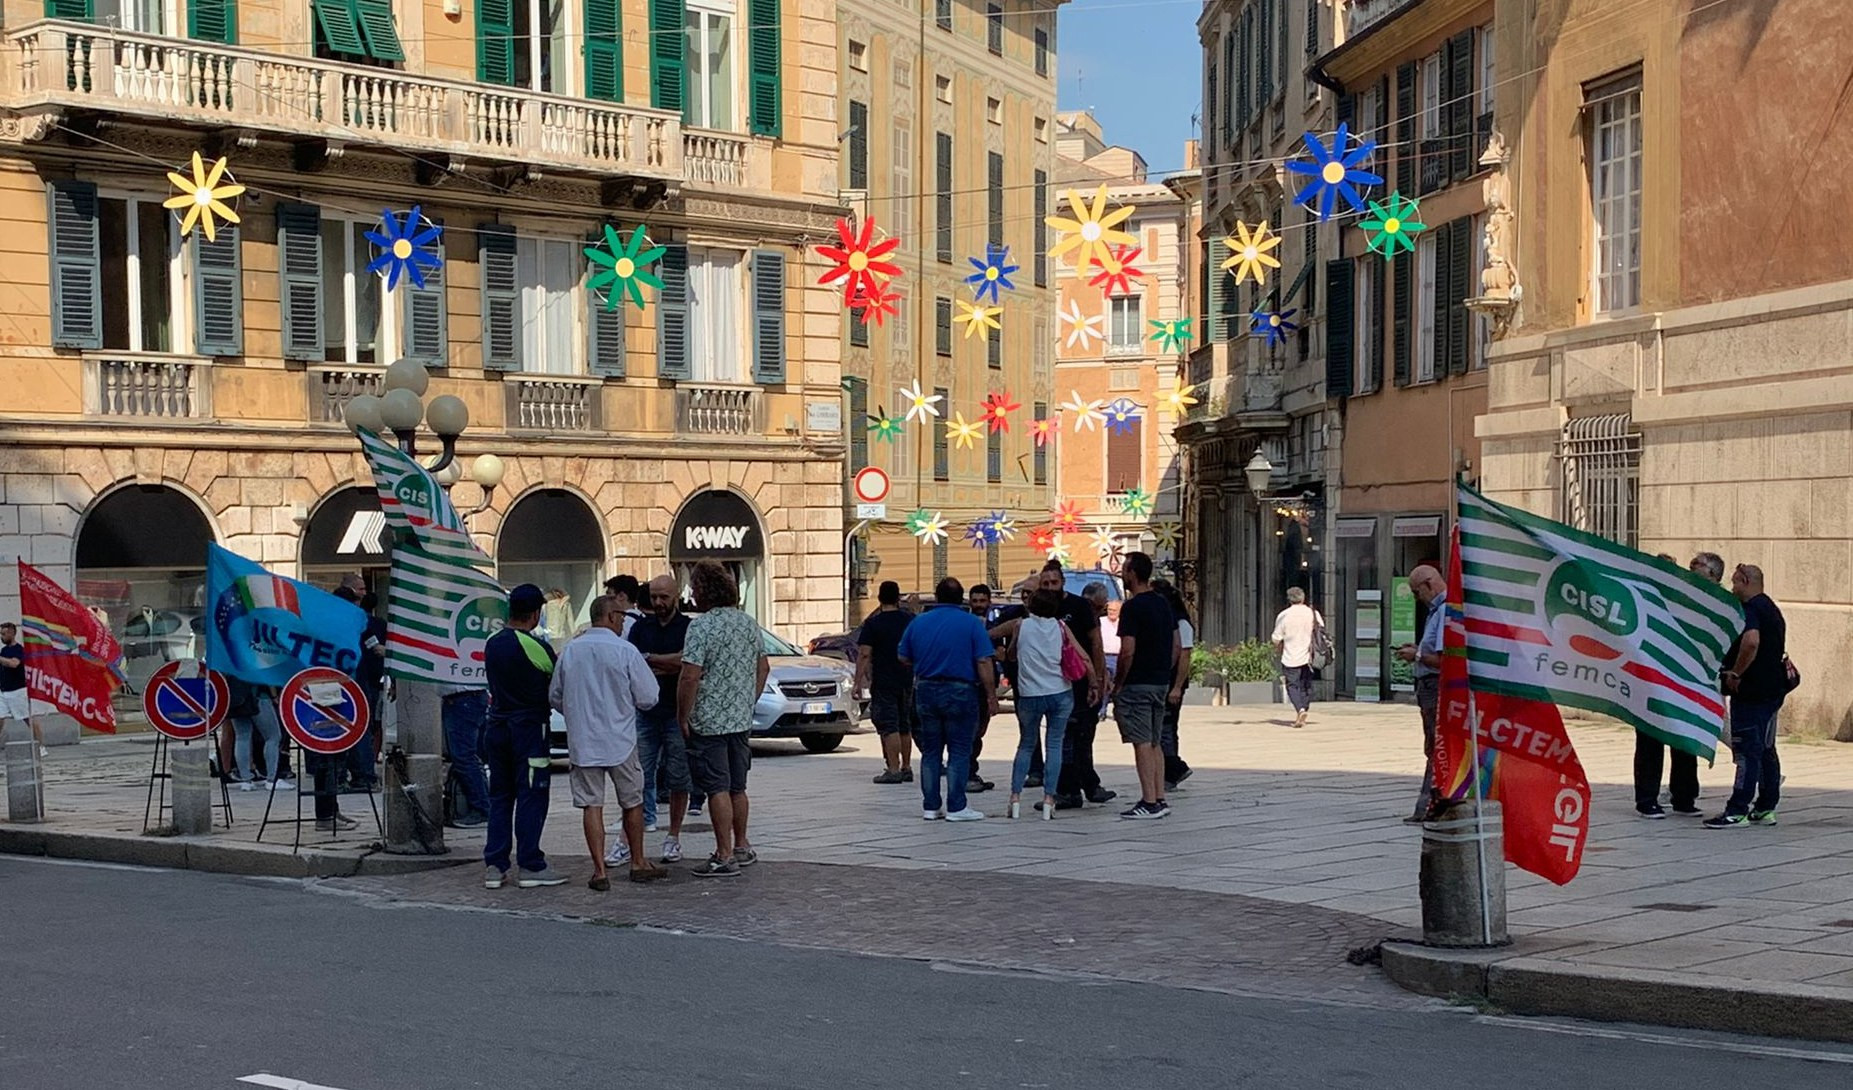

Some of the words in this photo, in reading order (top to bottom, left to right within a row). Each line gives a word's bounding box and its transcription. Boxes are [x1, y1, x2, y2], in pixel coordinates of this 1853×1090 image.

[399, 486, 428, 504] CIS
[1560, 582, 1627, 626] CISL
[465, 615, 506, 634] CIS
[449, 663, 487, 678] fem
[1534, 653, 1631, 698] femca
[1549, 774, 1584, 862] GIL
